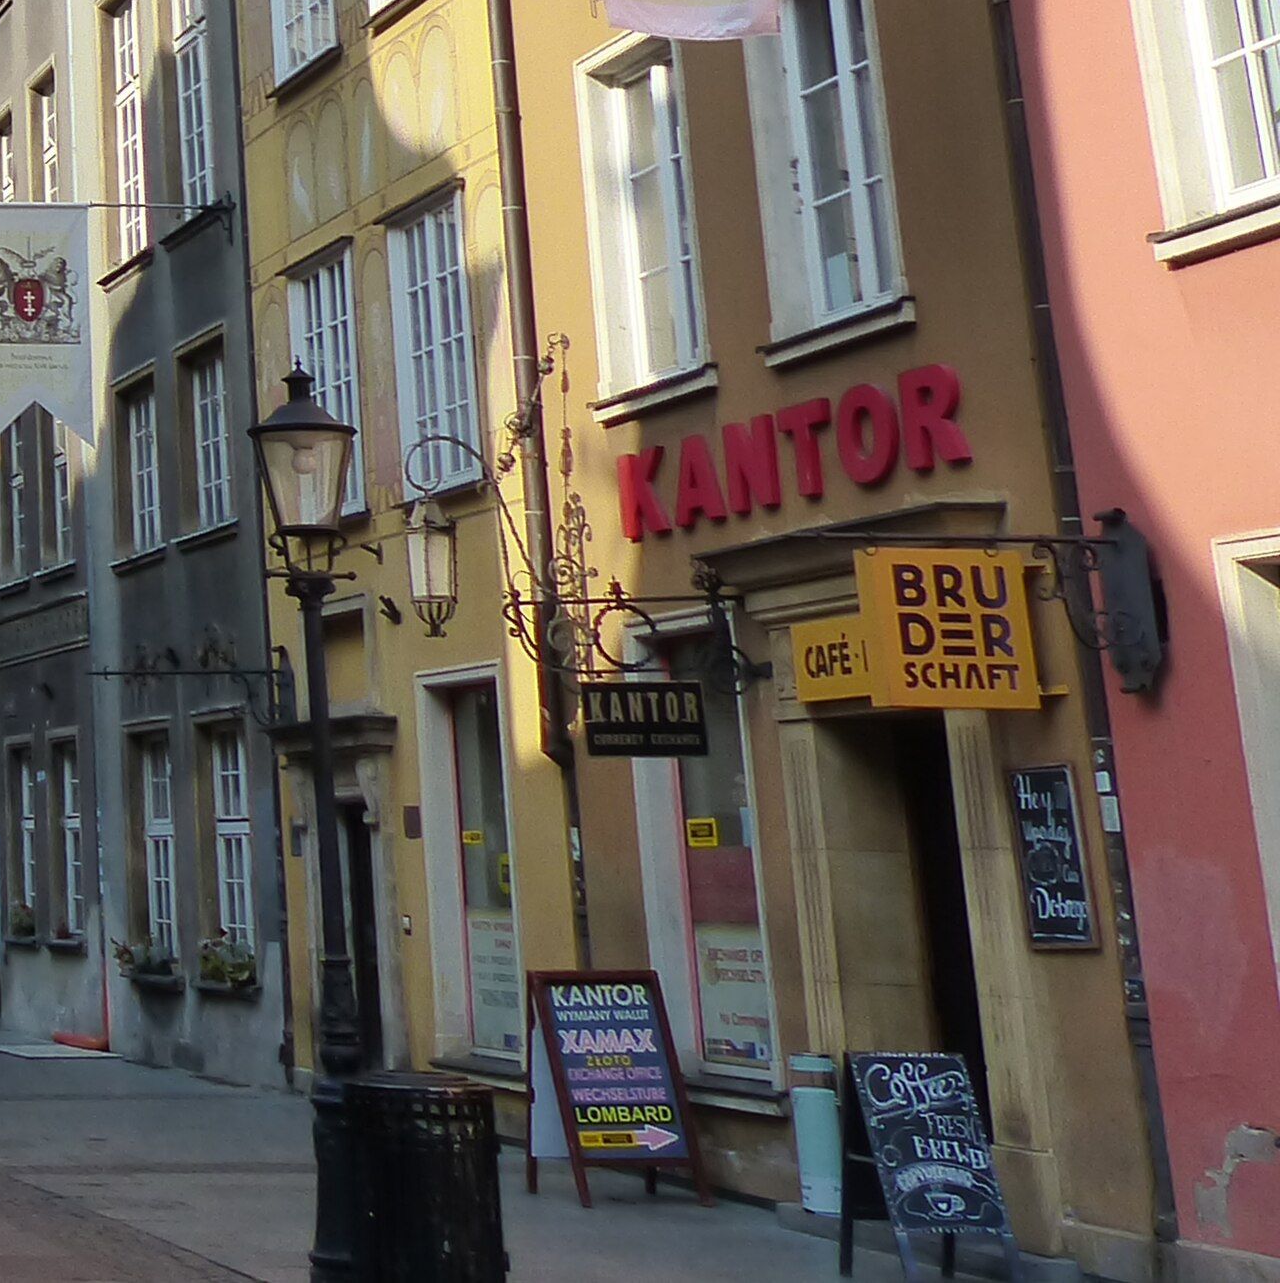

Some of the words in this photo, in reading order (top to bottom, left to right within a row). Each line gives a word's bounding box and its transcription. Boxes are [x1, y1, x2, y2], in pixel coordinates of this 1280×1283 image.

[616, 364, 974, 544] KANTOR
[891, 563, 1008, 609] BRU
[896, 612, 1015, 657] DER
[804, 633, 853, 678] CAFÉ
[903, 661, 1019, 690] SCHAFT
[588, 691, 700, 723] KANTOR
[1013, 774, 1054, 826] Hey
[551, 984, 649, 1007] KANTOR
[556, 1009, 611, 1022] WYMIANY
[613, 1009, 649, 1021] WALUT
[557, 1028, 657, 1054] XAMAX
[568, 1067, 626, 1081] EXCHANGE
[627, 1066, 663, 1080] OFFICE
[587, 1054, 632, 1066] ZŁOTO
[571, 1087, 667, 1101] WECHSELSTUBE
[864, 1062, 965, 1119] Coffee
[575, 1105, 673, 1124] LOMBARD
